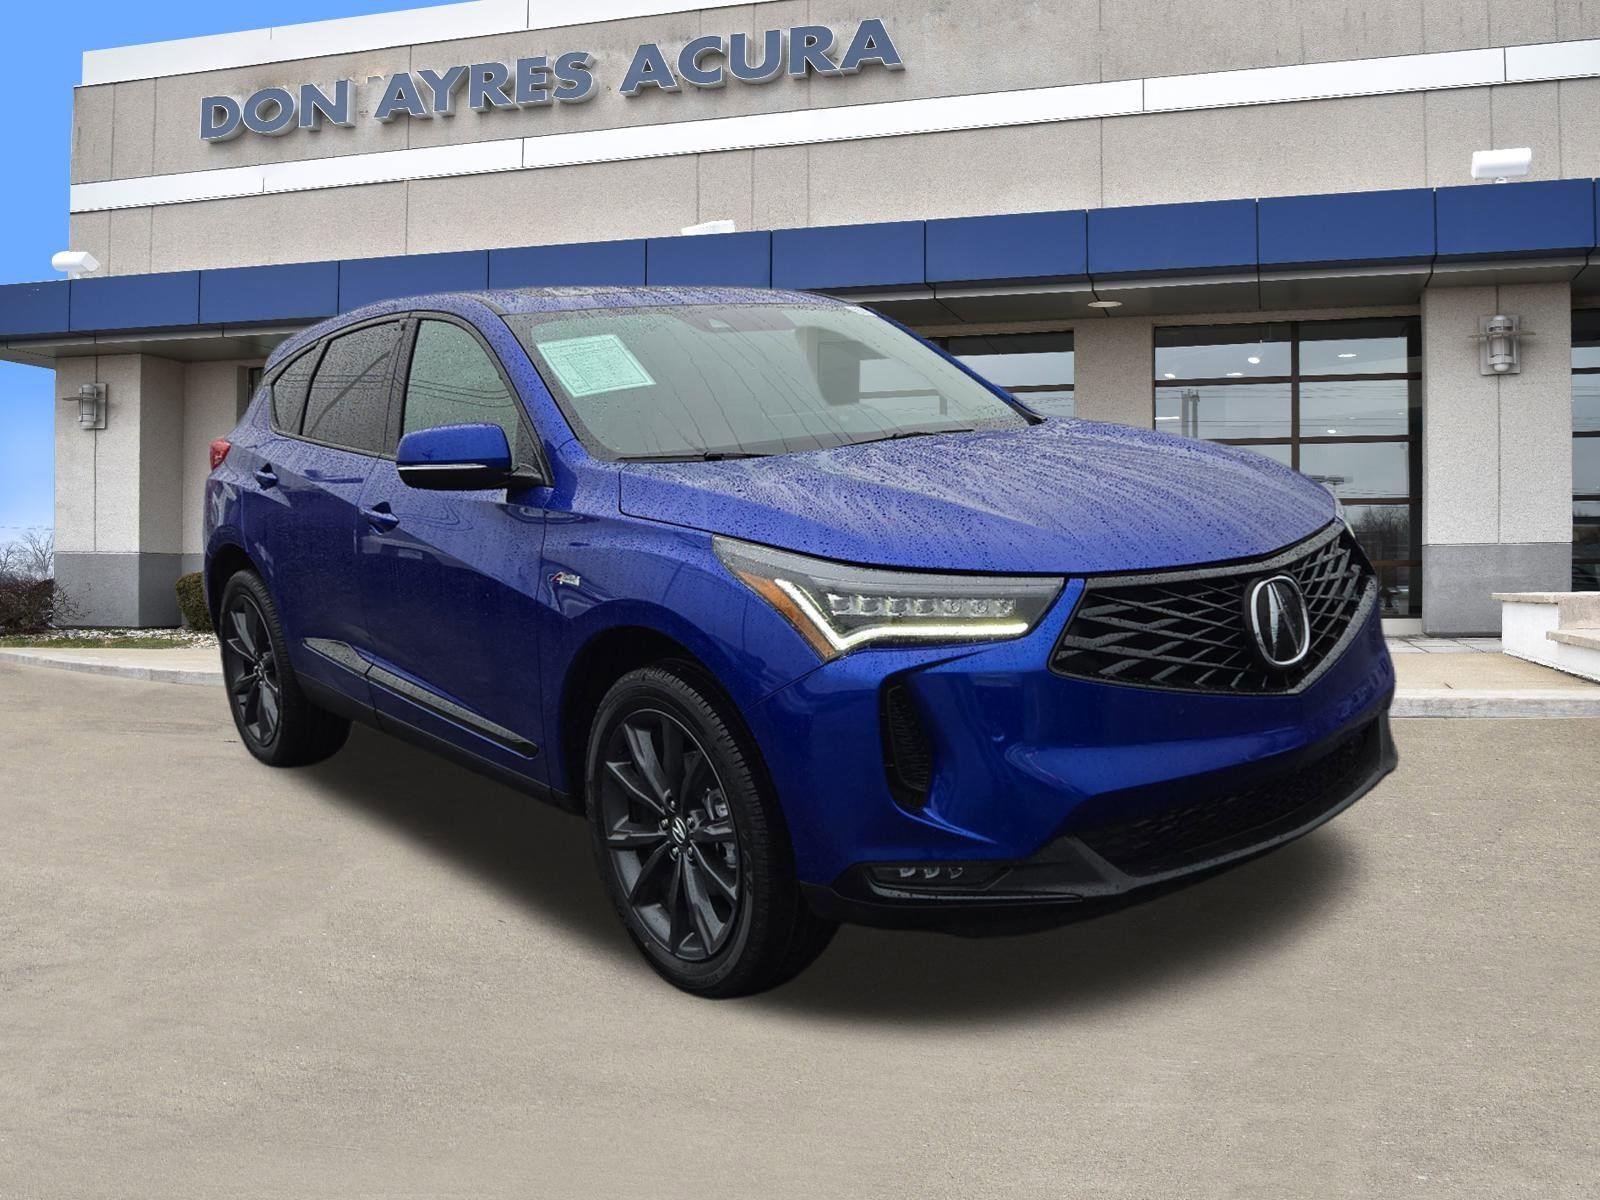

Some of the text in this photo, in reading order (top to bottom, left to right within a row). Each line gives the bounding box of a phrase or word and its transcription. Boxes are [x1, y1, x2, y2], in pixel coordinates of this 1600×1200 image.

[200, 17, 904, 142] DON AYRES ACURA
